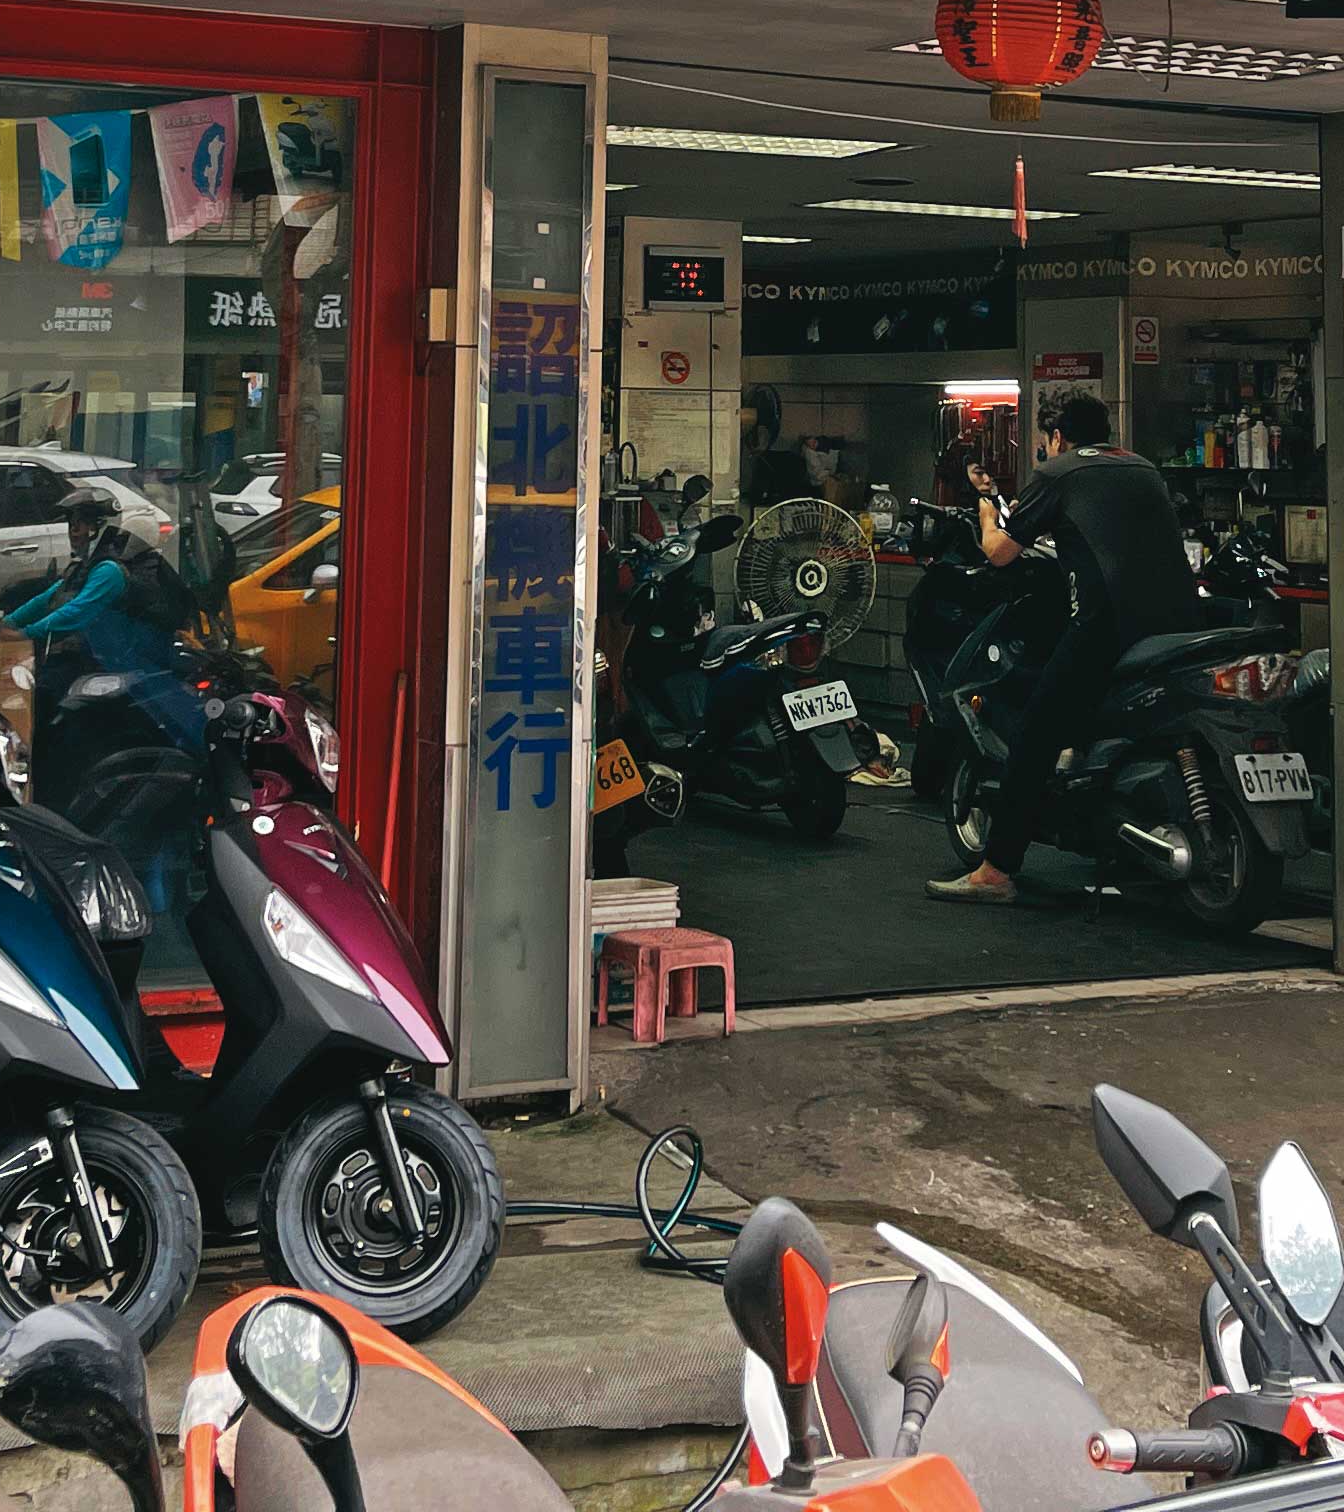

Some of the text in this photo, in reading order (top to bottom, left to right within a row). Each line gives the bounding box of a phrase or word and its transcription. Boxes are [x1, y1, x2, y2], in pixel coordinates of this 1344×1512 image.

[1017, 261, 1078, 282] KYMCO
[1083, 256, 1157, 279] KYMCO
[1166, 258, 1249, 279] KYMCO
[788, 691, 853, 723] NKW-7362
